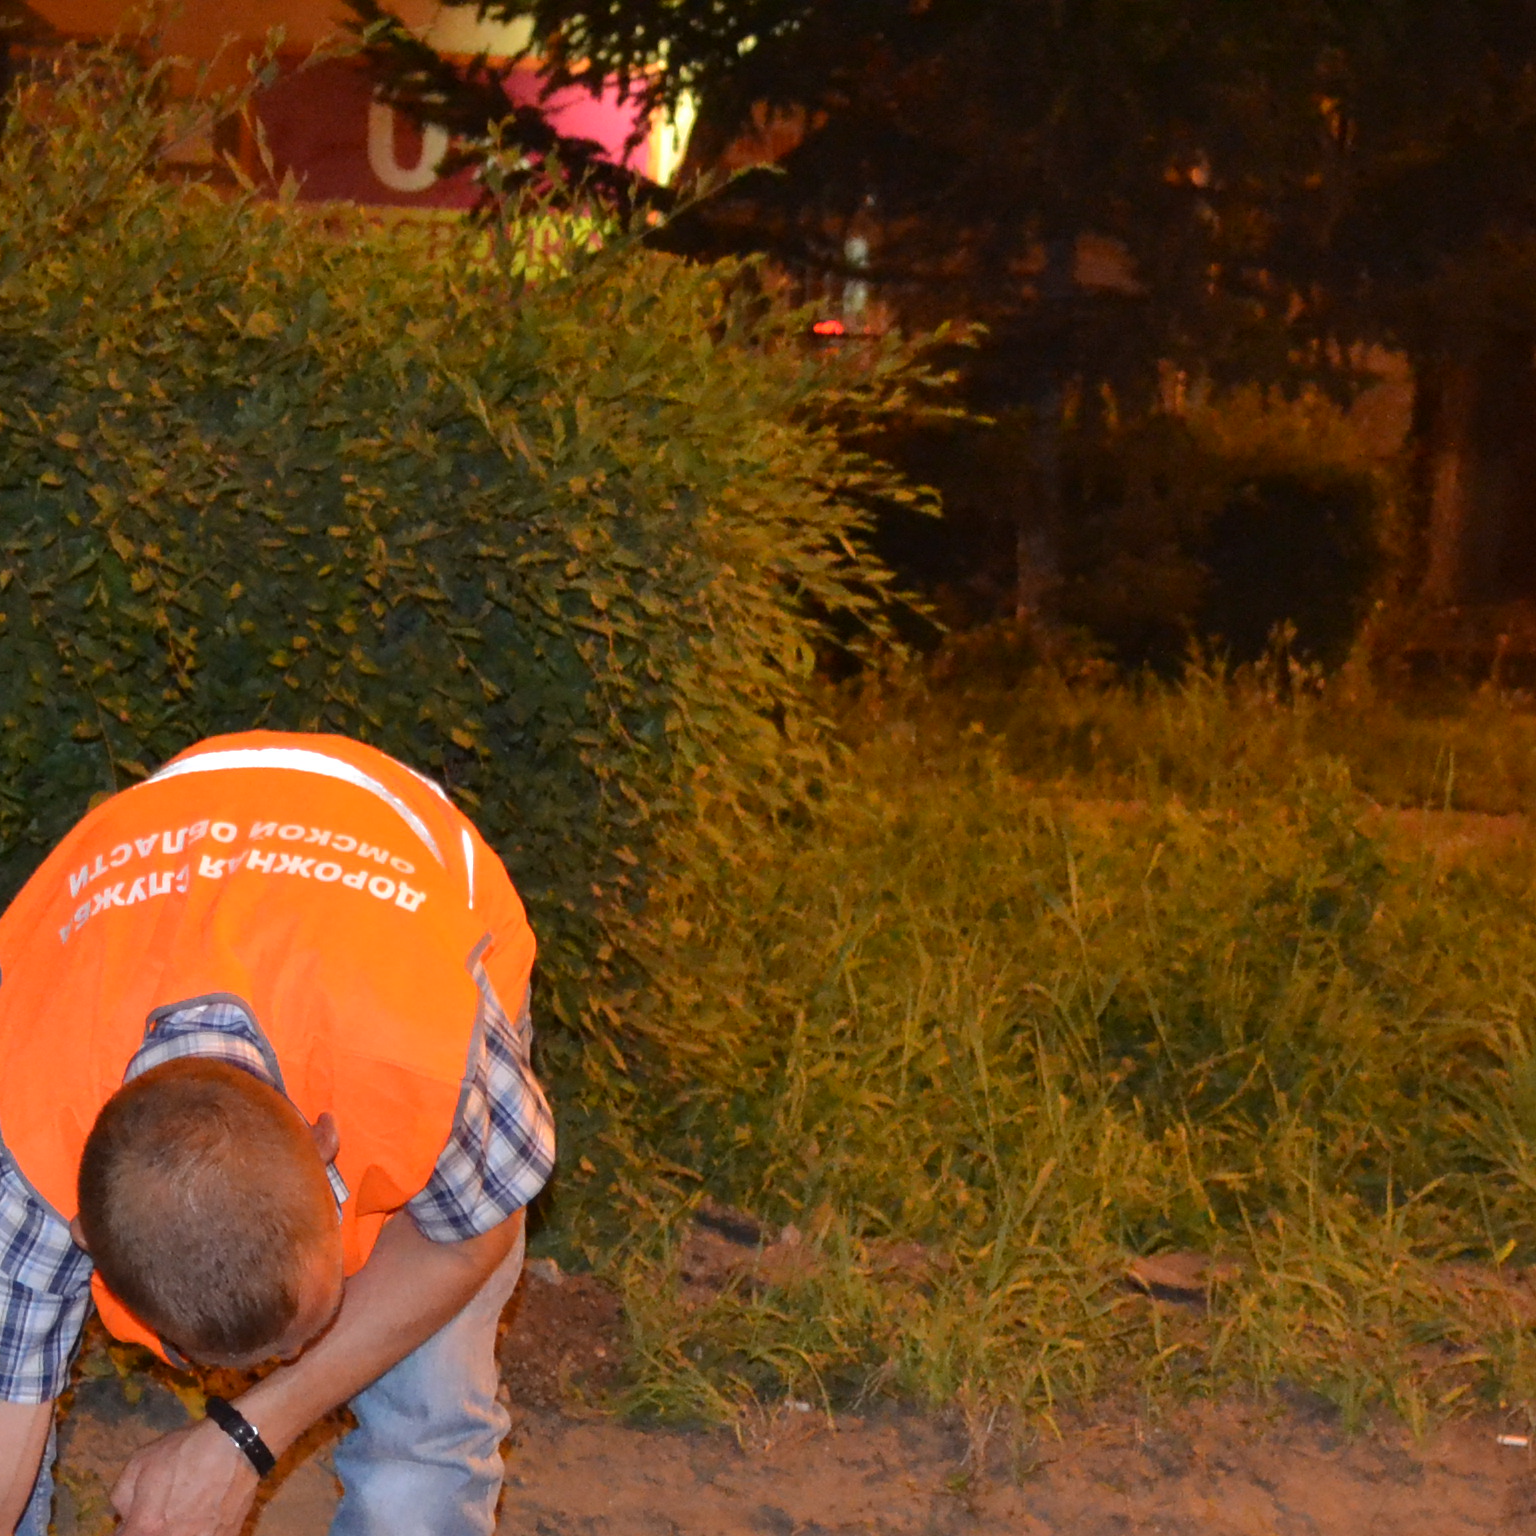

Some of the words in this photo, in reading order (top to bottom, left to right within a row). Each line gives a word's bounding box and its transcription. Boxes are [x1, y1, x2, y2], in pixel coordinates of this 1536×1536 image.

[69, 819, 238, 897] ОБЛАСТИ
[198, 850, 426, 912] ДОРОЖНАЯ
[250, 821, 415, 875] ОМСКОЙ
[59, 866, 189, 944] СЛУЖБА
